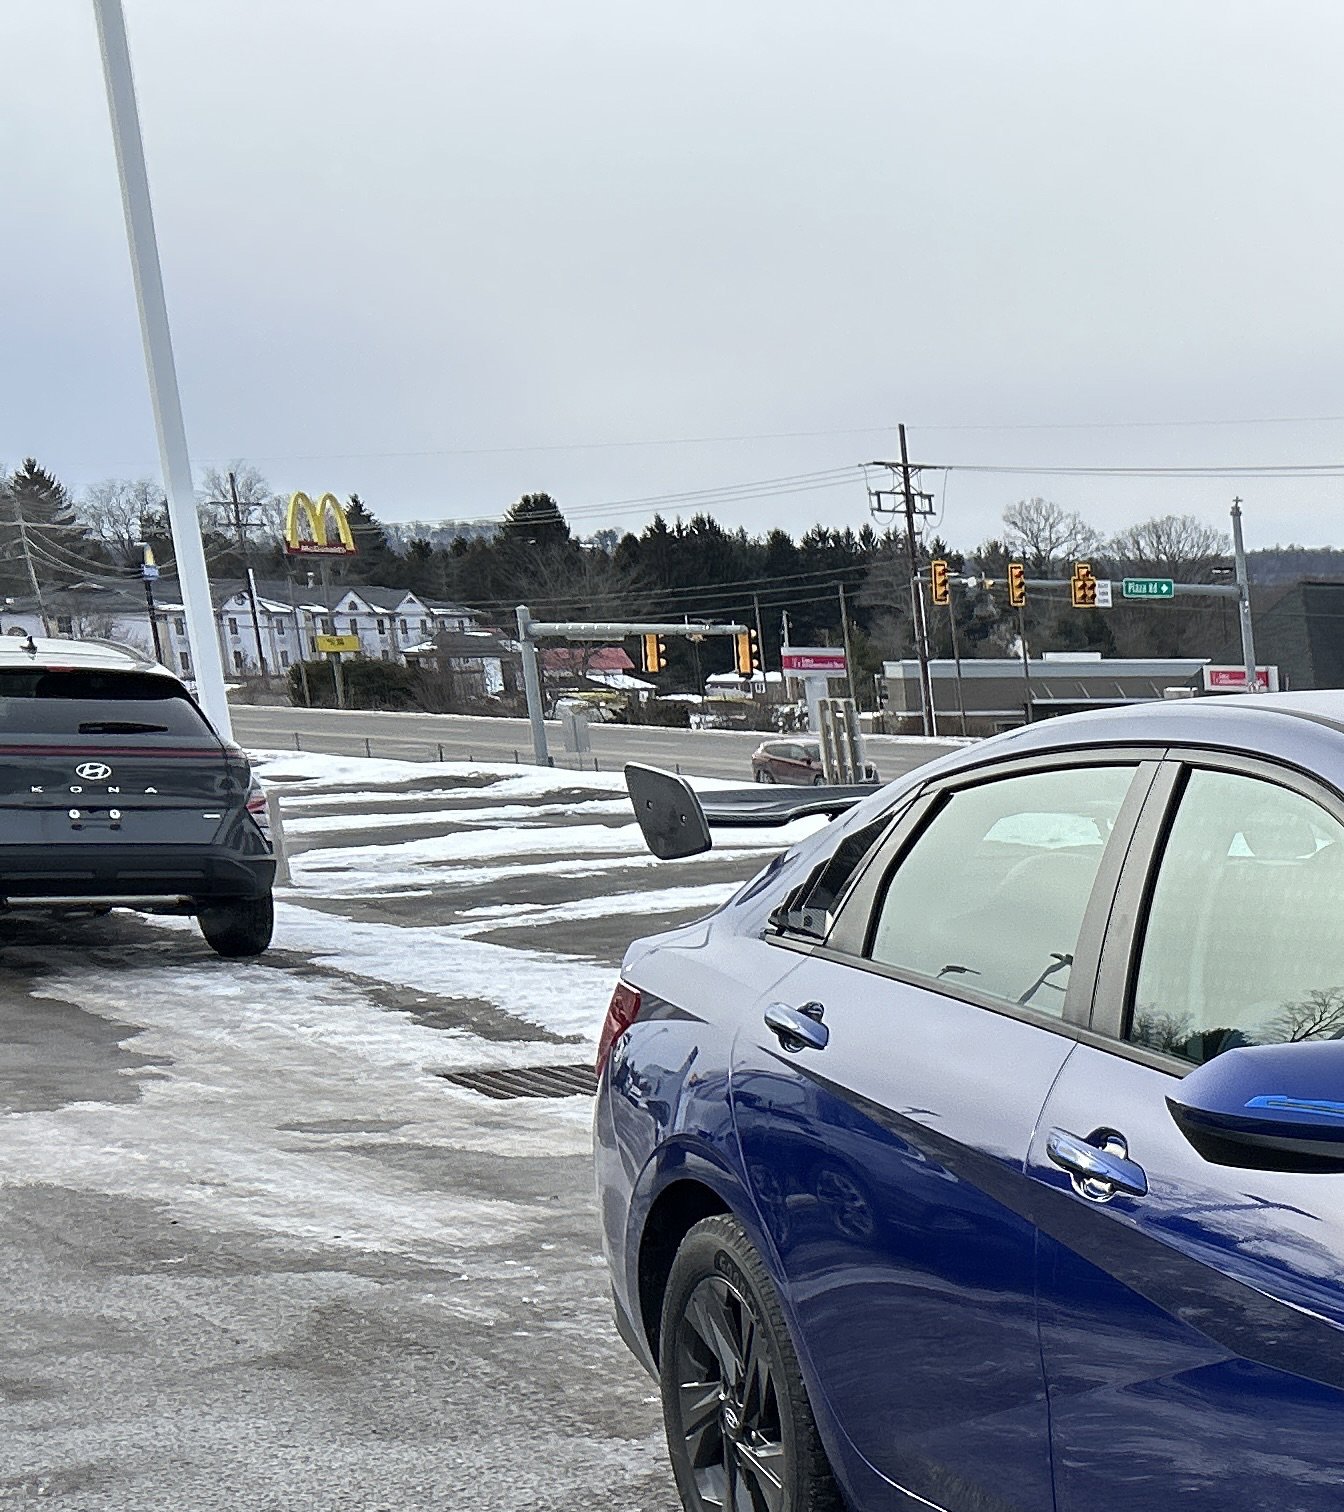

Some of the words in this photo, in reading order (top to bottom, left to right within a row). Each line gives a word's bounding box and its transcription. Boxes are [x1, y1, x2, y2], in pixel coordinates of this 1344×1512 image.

[1128, 582, 1147, 594] Plaza
[1149, 582, 1158, 594] Rd
[31, 785, 158, 795] KONA
